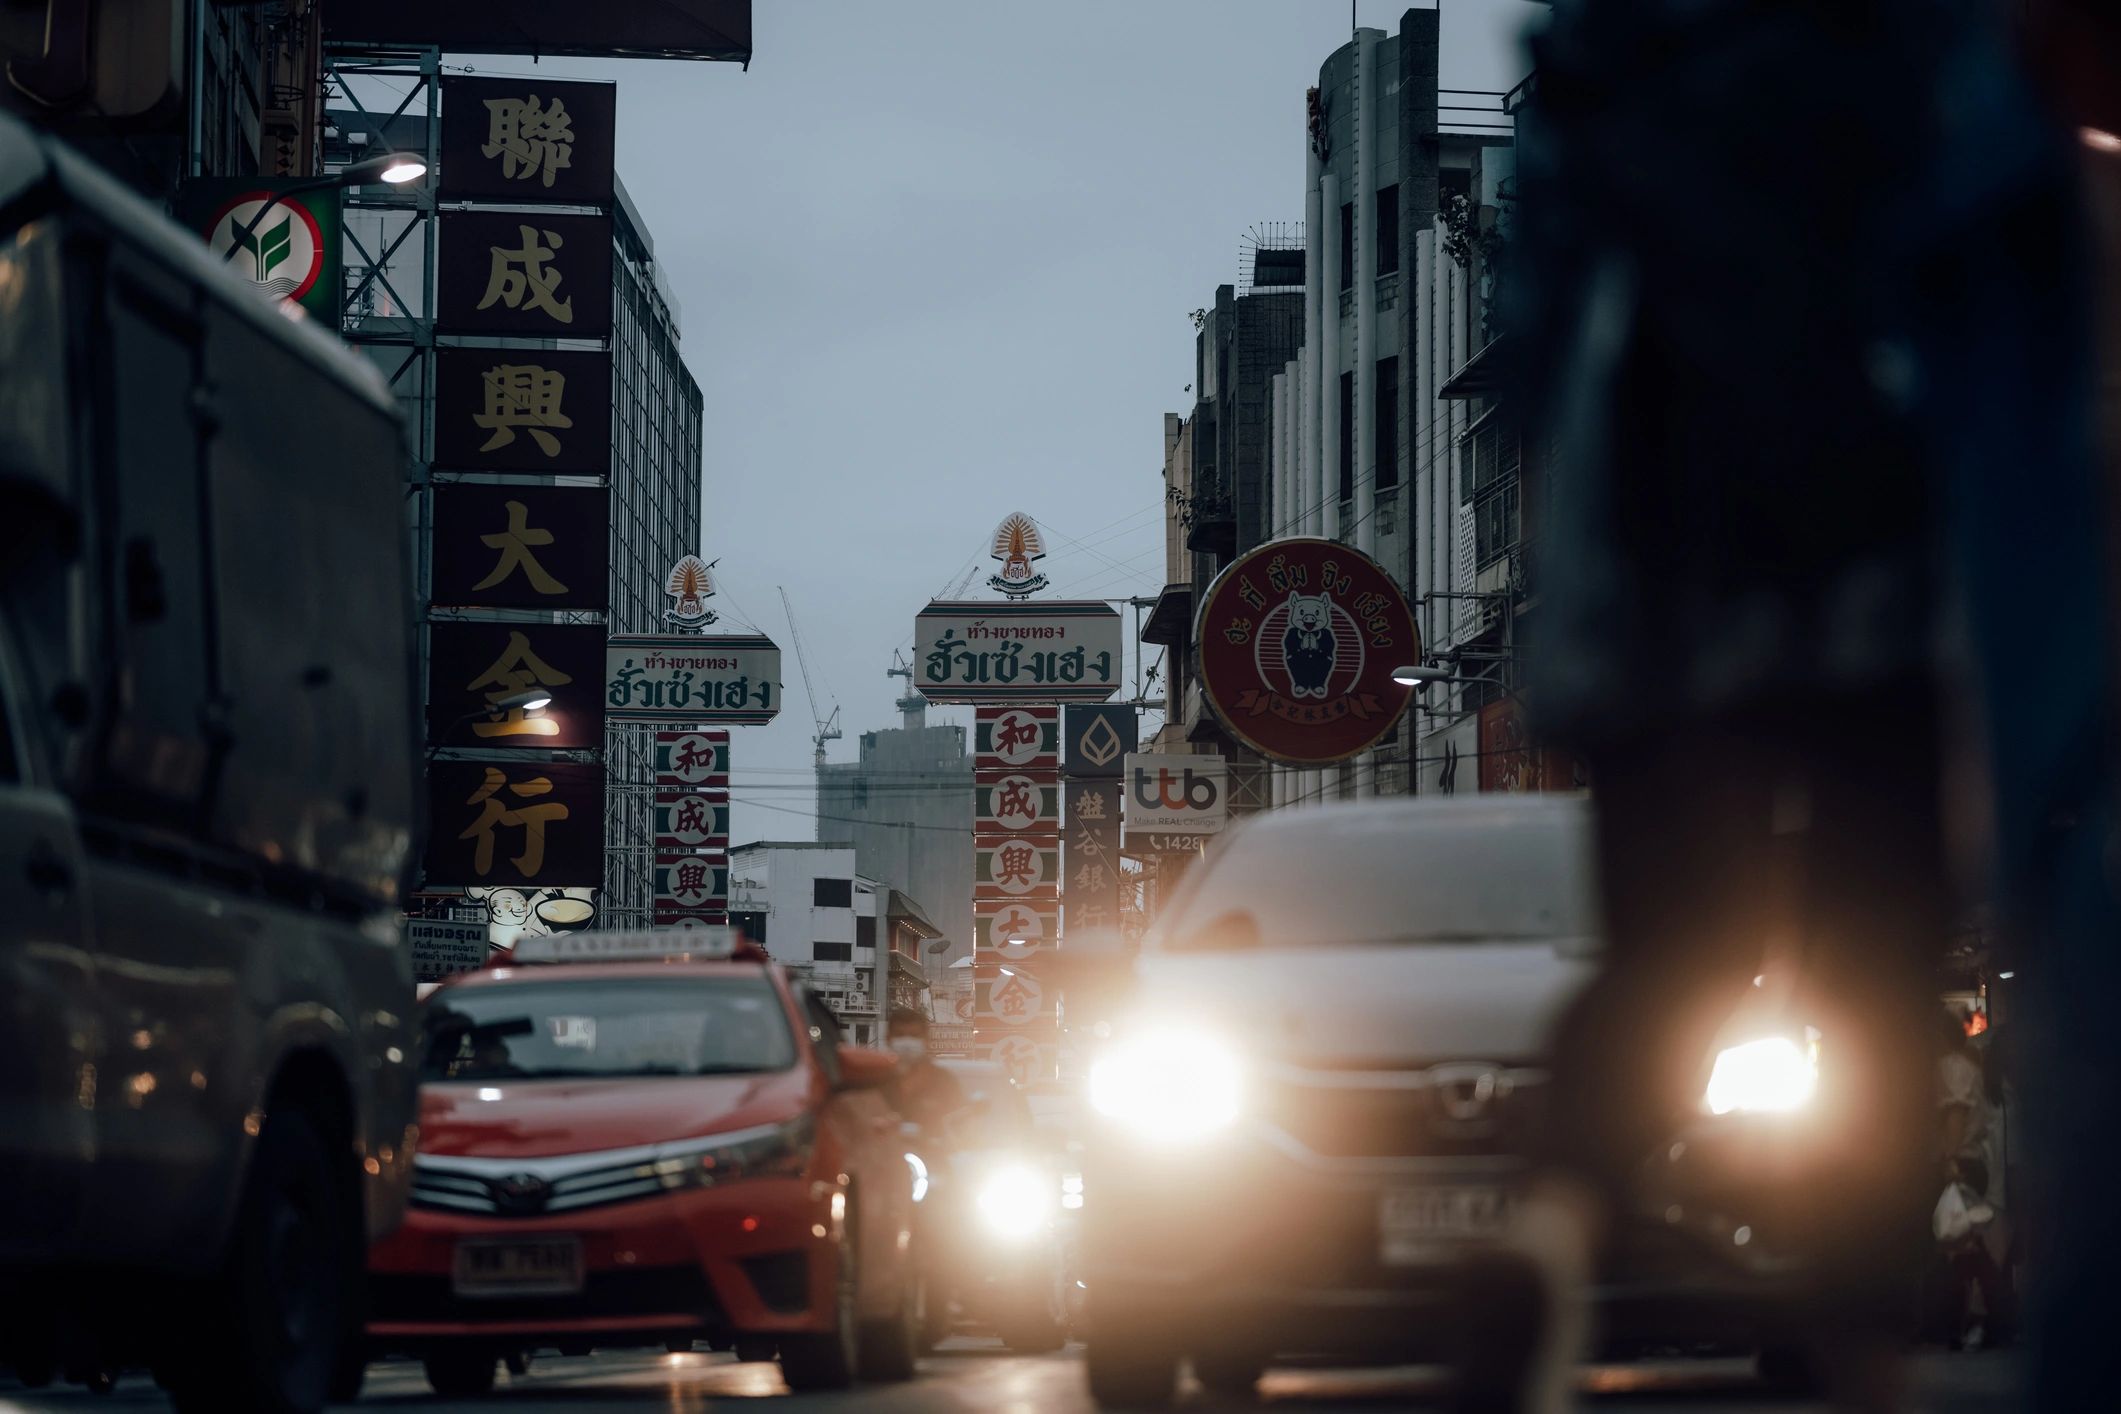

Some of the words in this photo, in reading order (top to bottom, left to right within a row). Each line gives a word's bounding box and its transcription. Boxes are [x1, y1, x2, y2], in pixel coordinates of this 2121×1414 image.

[459, 93, 576, 879] 聯成興大金行
[968, 620, 1065, 640] ห้างขายทอง
[644, 651, 738, 670] ห้างขายทอง
[926, 628, 1111, 684] ฮั่วเซ่งเฮง
[608, 658, 771, 709] ฮั่วเซ่งเฮง
[1134, 767, 1217, 811] ttb
[673, 740, 714, 928] 和成興
[1134, 817, 1156, 825] Make
[1158, 817, 1182, 826] REAL
[1184, 818, 1216, 827] Change
[1163, 836, 1200, 850] 1428
